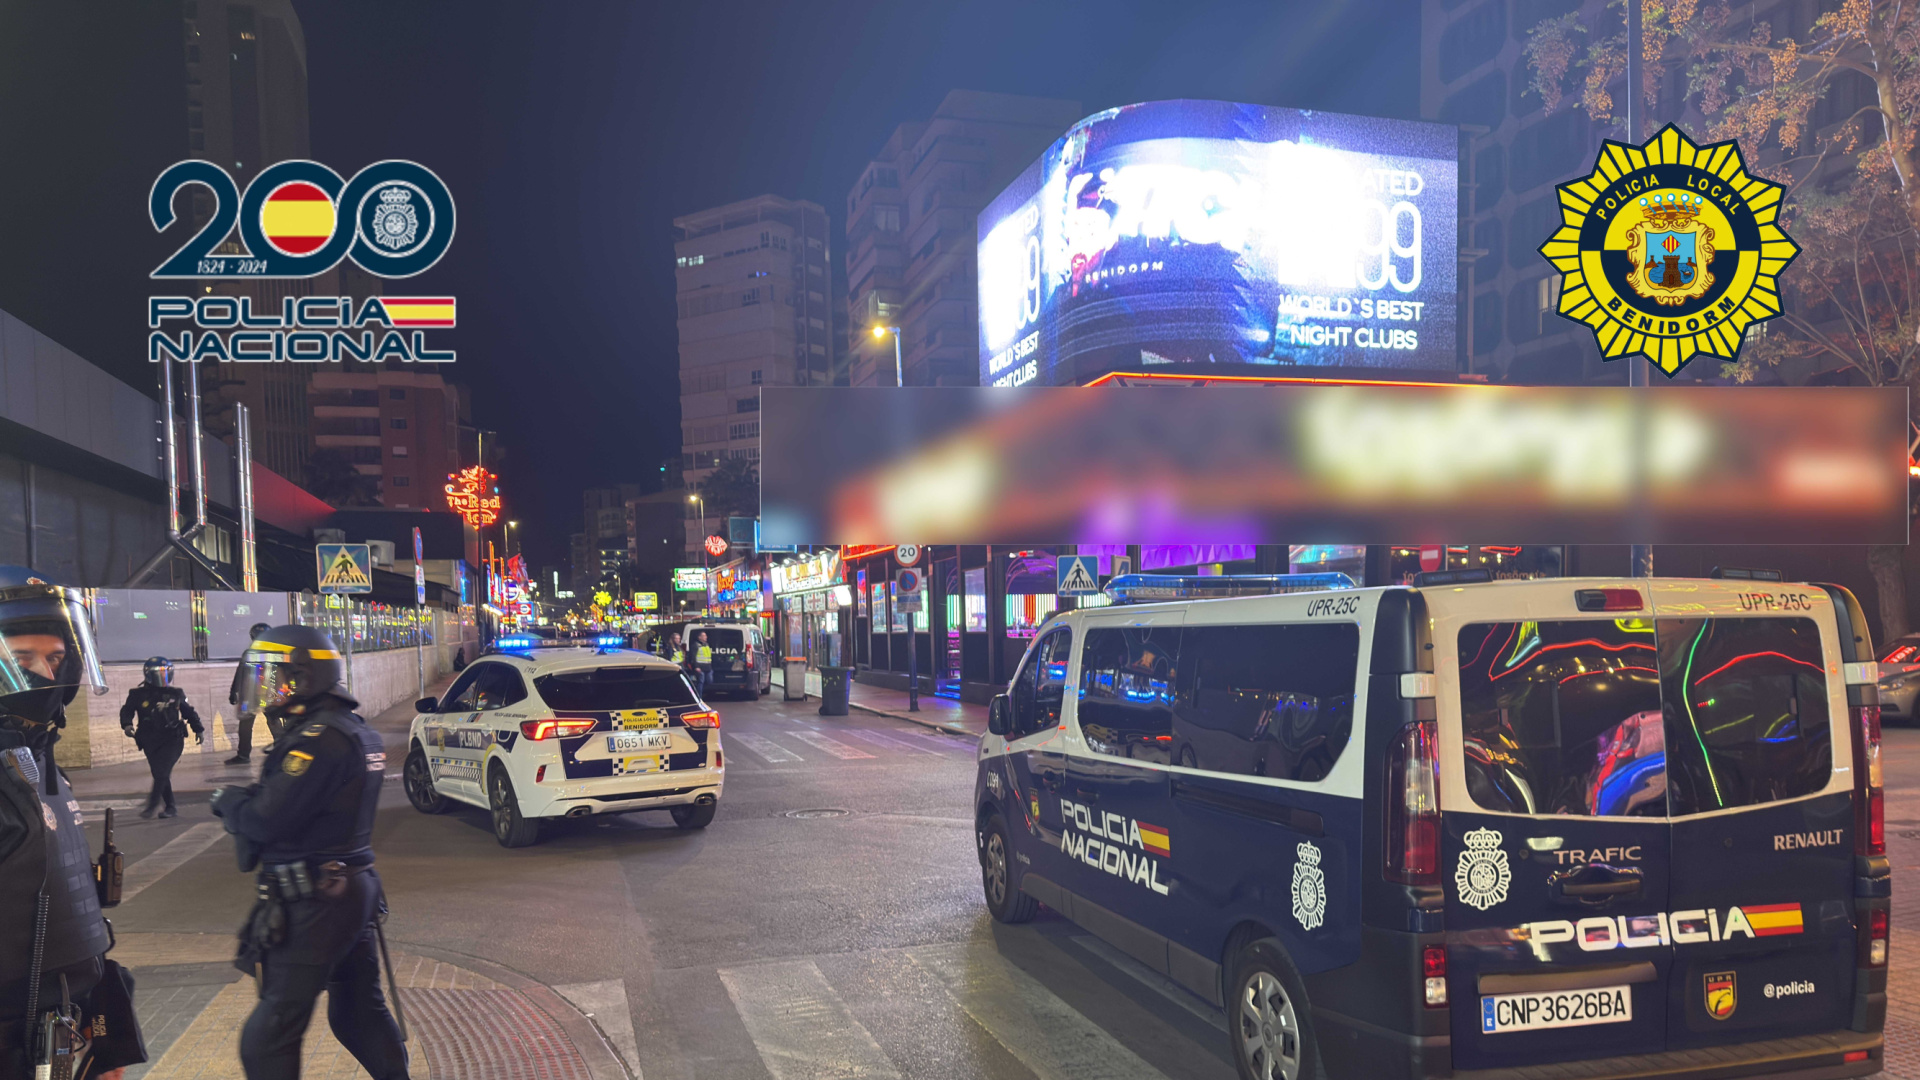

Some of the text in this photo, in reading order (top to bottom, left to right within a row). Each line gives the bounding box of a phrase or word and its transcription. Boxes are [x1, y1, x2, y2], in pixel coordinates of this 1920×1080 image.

[1376, 299, 1424, 321] BEST
[1290, 325, 1418, 350] NIGHT CLUBS
[900, 547, 916, 558] 20
[1307, 596, 1360, 617] UPR-25C
[1738, 593, 1811, 611] UPR-25C
[617, 735, 668, 749] 0651 MKV
[1774, 829, 1843, 851] RENAULT
[1061, 829, 1169, 896] NACIONAL
[1553, 846, 1642, 865] TRAFIC
[1763, 980, 1815, 999] @policia
[1496, 989, 1626, 1026] CNP3626BA
